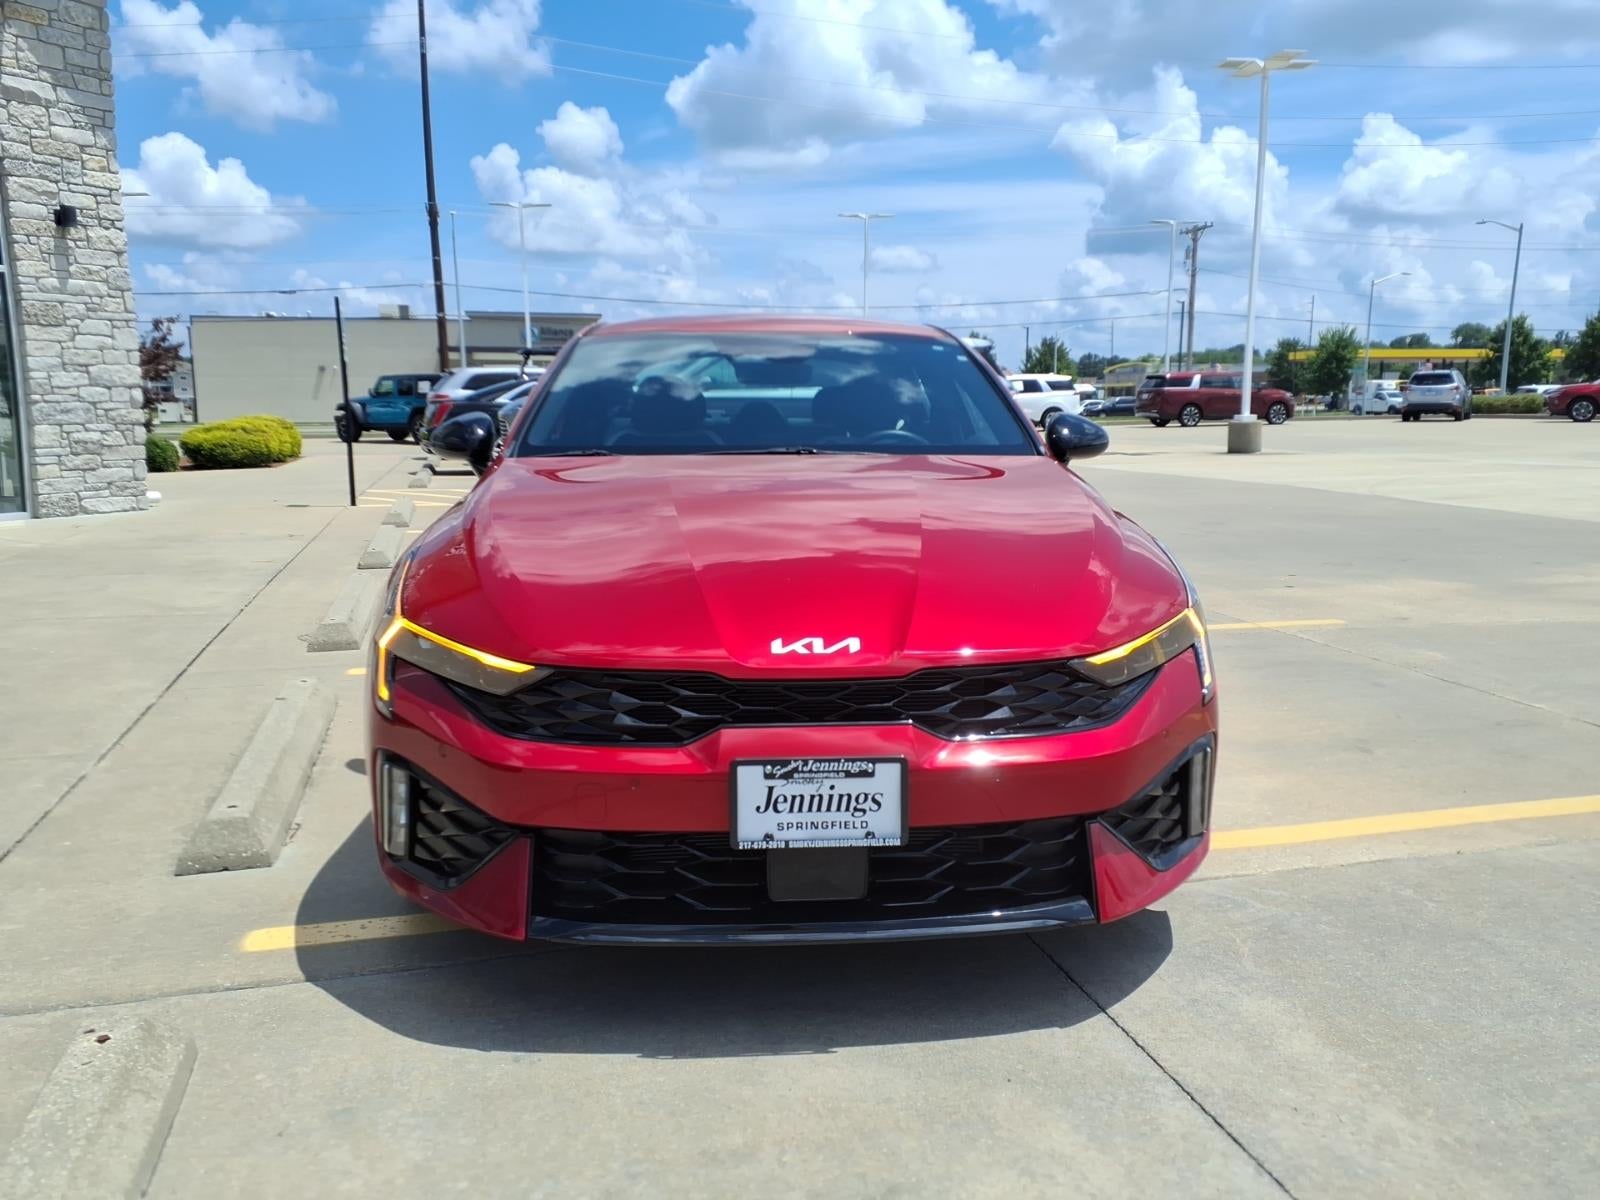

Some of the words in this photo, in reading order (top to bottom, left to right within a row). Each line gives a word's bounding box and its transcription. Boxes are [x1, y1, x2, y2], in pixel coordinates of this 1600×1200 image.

[771, 637, 860, 655] KIA
[803, 758, 868, 774] Jennings
[756, 785, 883, 818] Jennings
[777, 820, 868, 832] SPRINGFIELD
